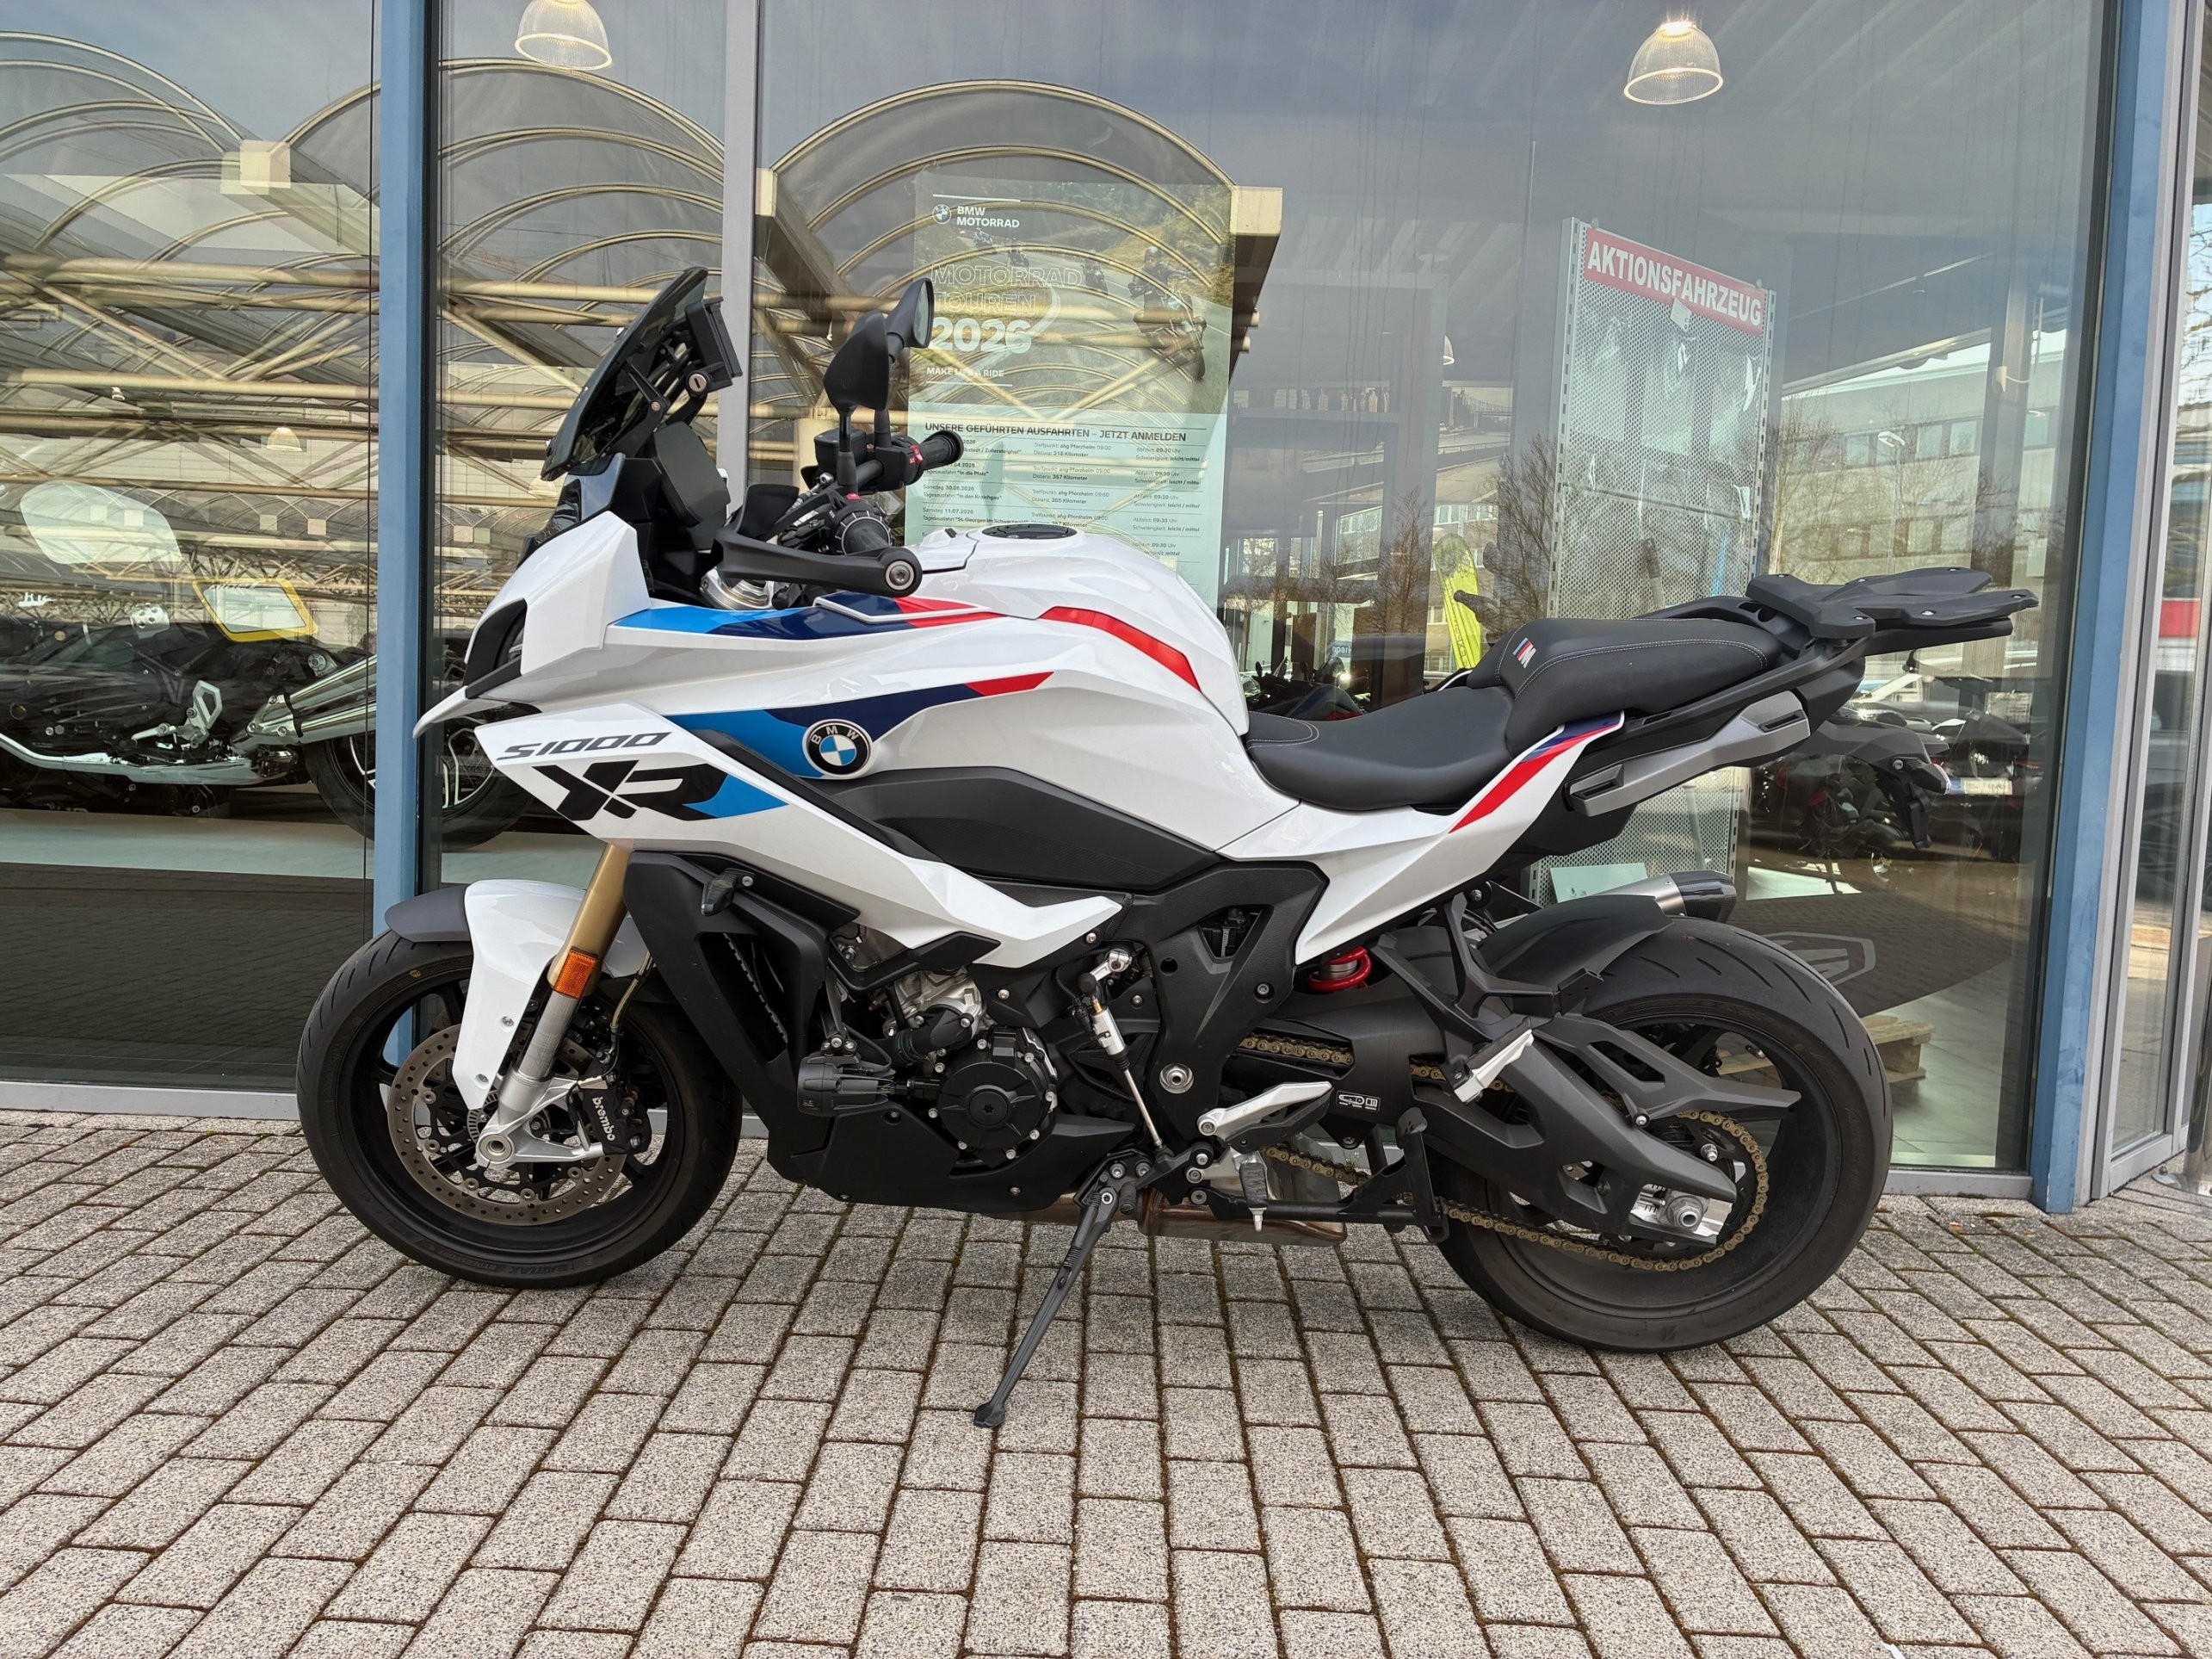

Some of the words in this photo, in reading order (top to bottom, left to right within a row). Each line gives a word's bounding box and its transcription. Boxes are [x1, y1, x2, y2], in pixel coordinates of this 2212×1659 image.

[956, 217, 1021, 228] MOTORRAD
[957, 206, 986, 216] BMW
[930, 263, 1083, 288] MOTORRAD
[1588, 241, 1761, 325] AKTIONSFAHRZEUG
[933, 291, 1036, 315] TOUREN
[930, 316, 1033, 354] 2026
[924, 422, 964, 432] UNSERE
[966, 424, 1024, 435] GEFÜHRTEN
[1027, 426, 1090, 437] AUSFAHRTEN
[1099, 430, 1128, 439] JETZT
[1131, 431, 1186, 442] ANMELDEN
[497, 732, 672, 760] S1000
[810, 724, 860, 745] BMW
[531, 759, 730, 821] XR
[591, 1096, 616, 1142] brembo
